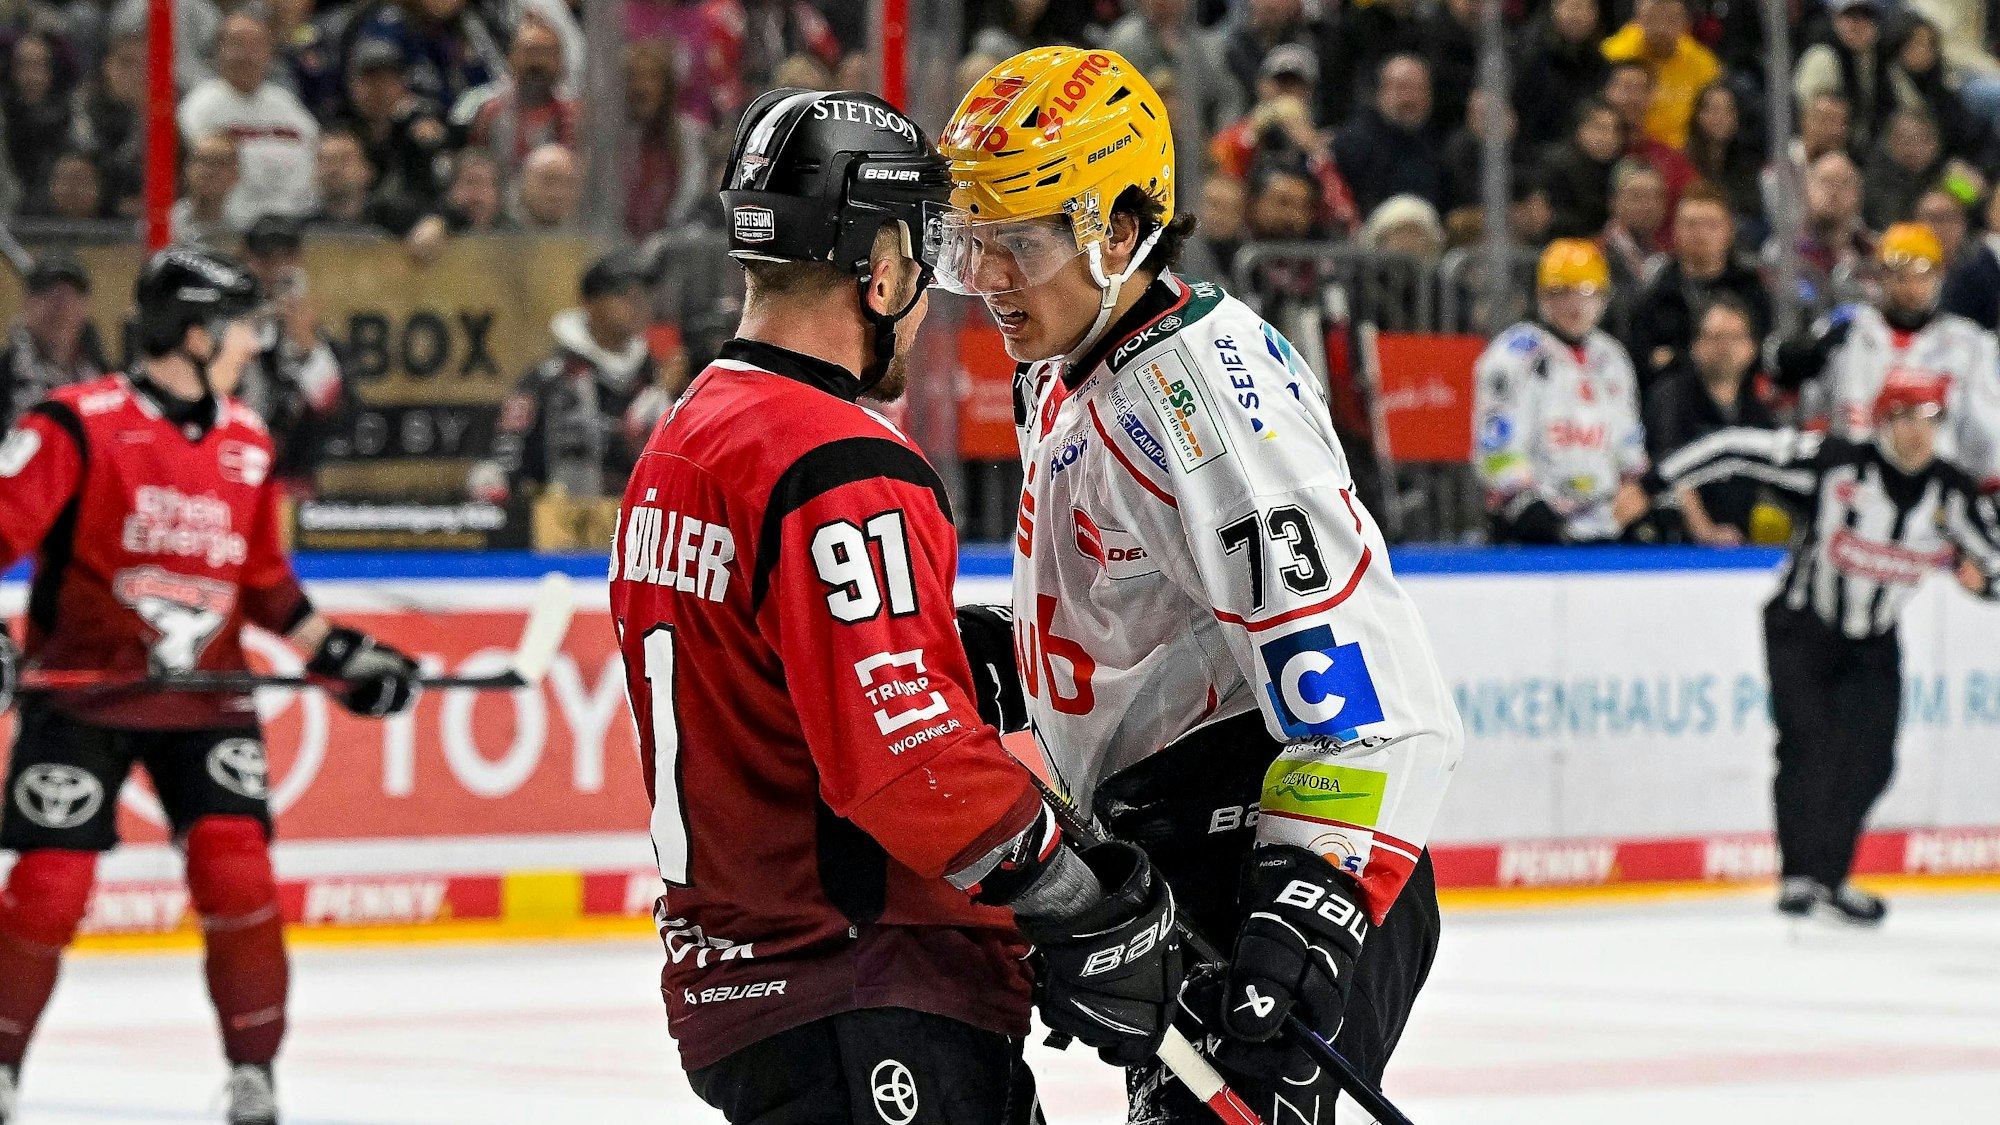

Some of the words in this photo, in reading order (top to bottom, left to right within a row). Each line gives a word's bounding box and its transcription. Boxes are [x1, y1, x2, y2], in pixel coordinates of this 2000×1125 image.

[1053, 54, 1110, 113] LOTTO
[813, 100, 918, 143] STETSON
[864, 168, 920, 182] BAUER
[1087, 134, 1132, 165] BAUER
[735, 211, 772, 228] STETSON
[351, 311, 498, 377] BOX
[1114, 329, 1160, 368] AOK
[1169, 380, 1197, 418] BSG
[1131, 426, 1170, 470] CAMPU
[1159, 398, 1196, 463] Sandhandel
[811, 508, 920, 625] 91
[1215, 504, 1332, 616] 73
[1013, 593, 1096, 716] wb
[384, 648, 628, 797] TOY
[1282, 772, 1341, 792] GEWOBA
[1273, 879, 1368, 946] BAU
[1079, 906, 1175, 978] BAU
[700, 980, 787, 1003] BAUER
